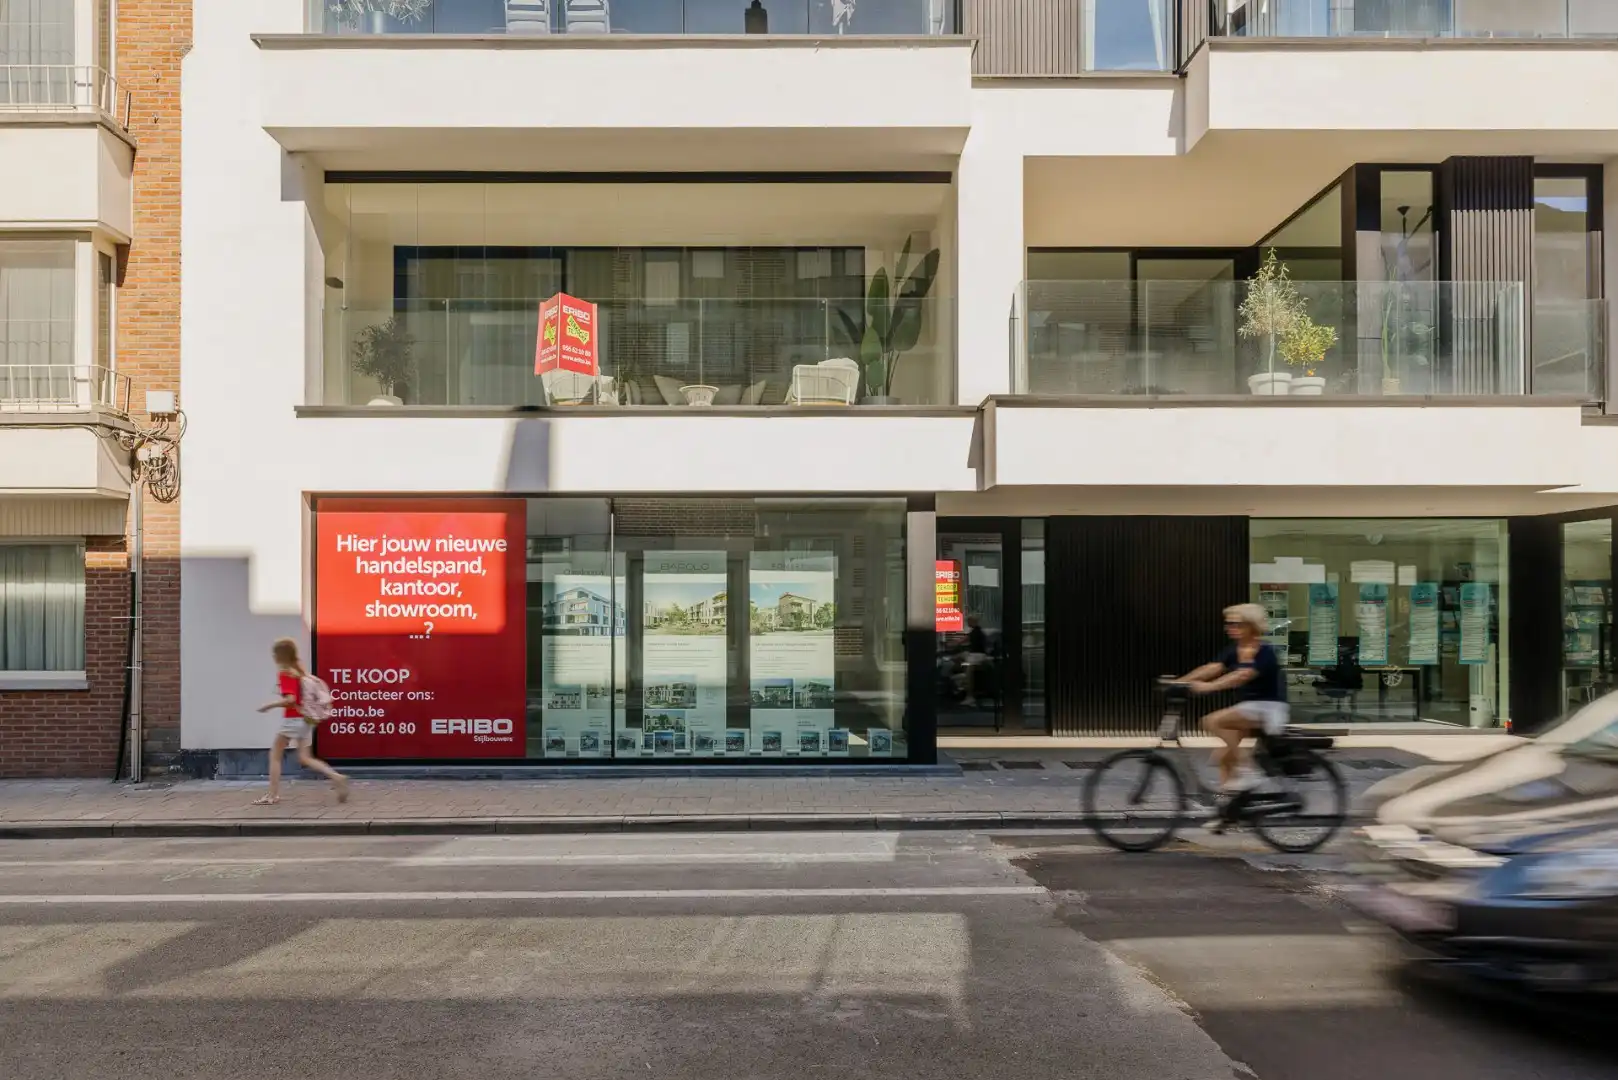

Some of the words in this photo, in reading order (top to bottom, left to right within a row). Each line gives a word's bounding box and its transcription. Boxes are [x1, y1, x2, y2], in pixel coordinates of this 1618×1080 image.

[562, 305, 590, 321] ERIBO
[336, 534, 377, 552] Hier
[380, 534, 431, 556] jouw
[435, 534, 508, 552] nieuwe
[356, 556, 487, 578] handelspand,
[380, 578, 462, 598] kantoor,
[365, 600, 478, 620] showroom,
[330, 668, 352, 684] TE
[356, 668, 410, 684] KOOP
[330, 689, 403, 700] Contacteer
[406, 690, 434, 700] ons:
[330, 706, 384, 718] eribo.be
[330, 722, 355, 734] 056
[358, 722, 376, 734] 62
[379, 722, 395, 734] 10
[398, 722, 416, 734] 80
[430, 718, 513, 734] ERIBO
[473, 735, 513, 744] Stijlbouwers
